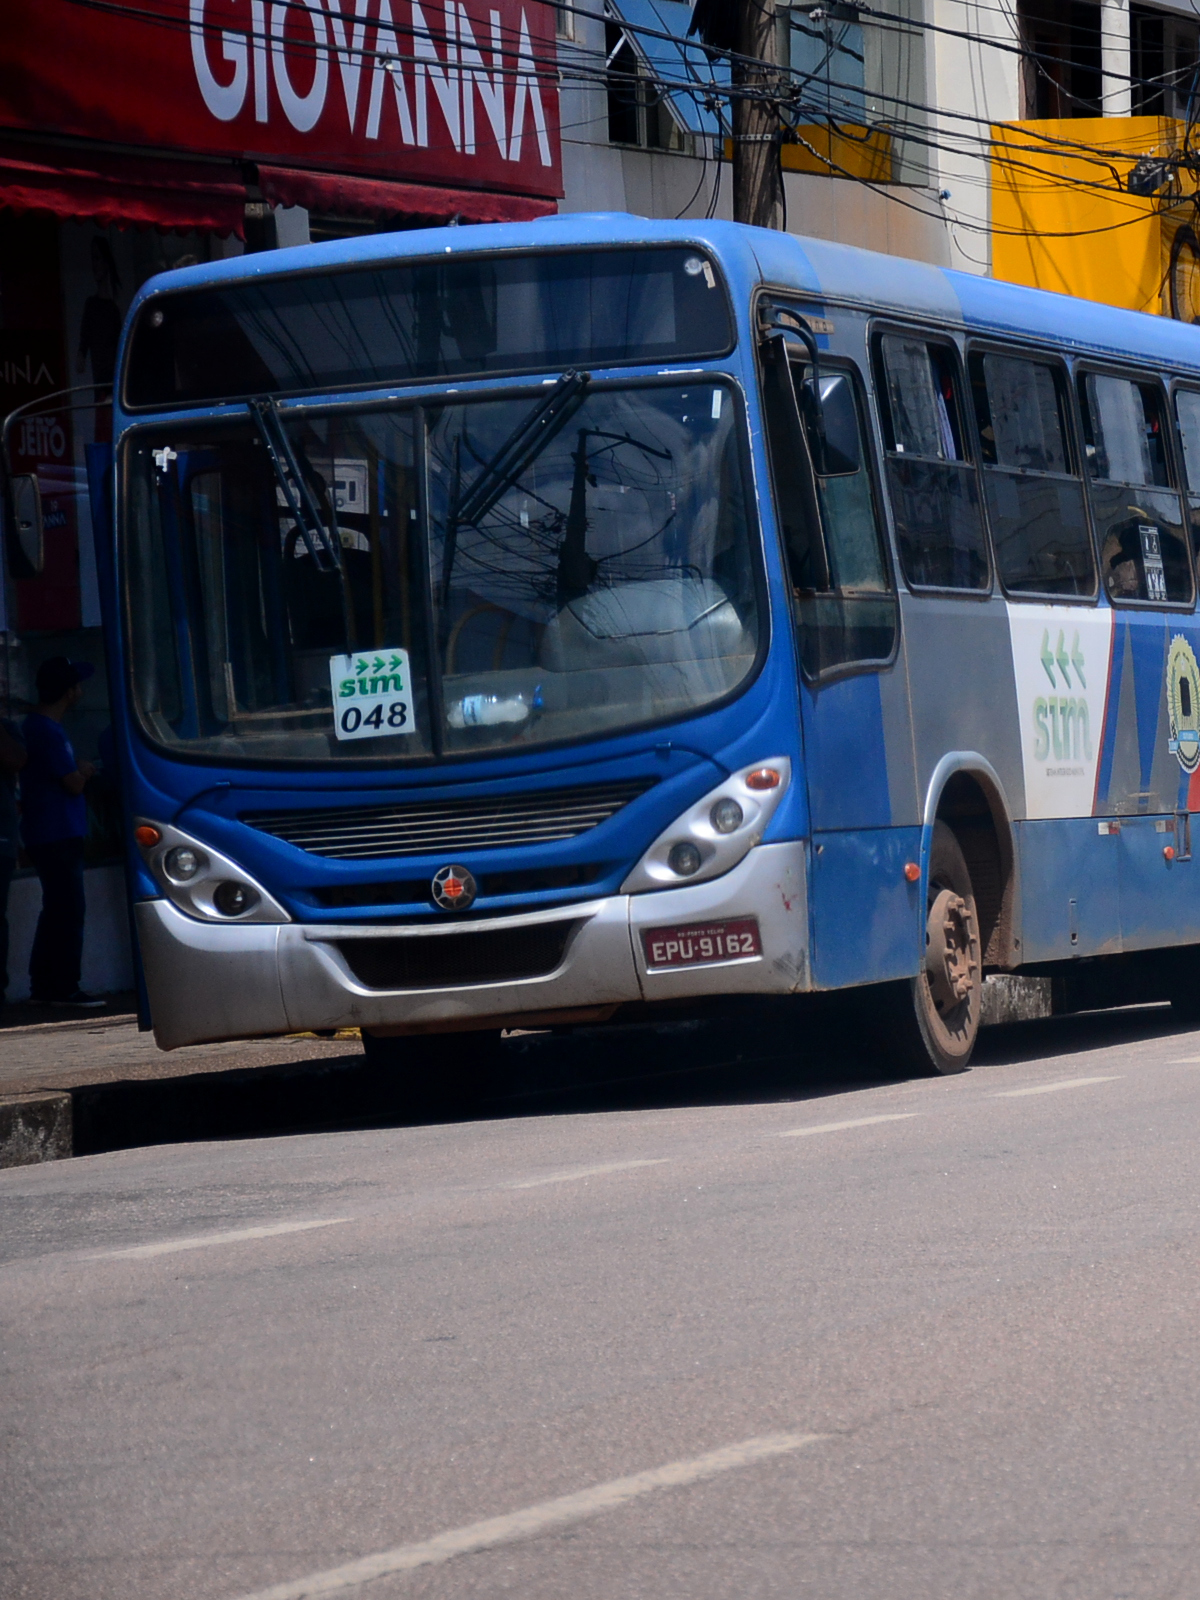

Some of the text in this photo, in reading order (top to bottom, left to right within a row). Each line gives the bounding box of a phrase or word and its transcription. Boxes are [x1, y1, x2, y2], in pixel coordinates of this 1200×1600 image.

[189, 0, 552, 167] GIOVANNA
[18, 424, 66, 458] JEITO
[339, 673, 403, 697] sim
[340, 702, 407, 733] 048
